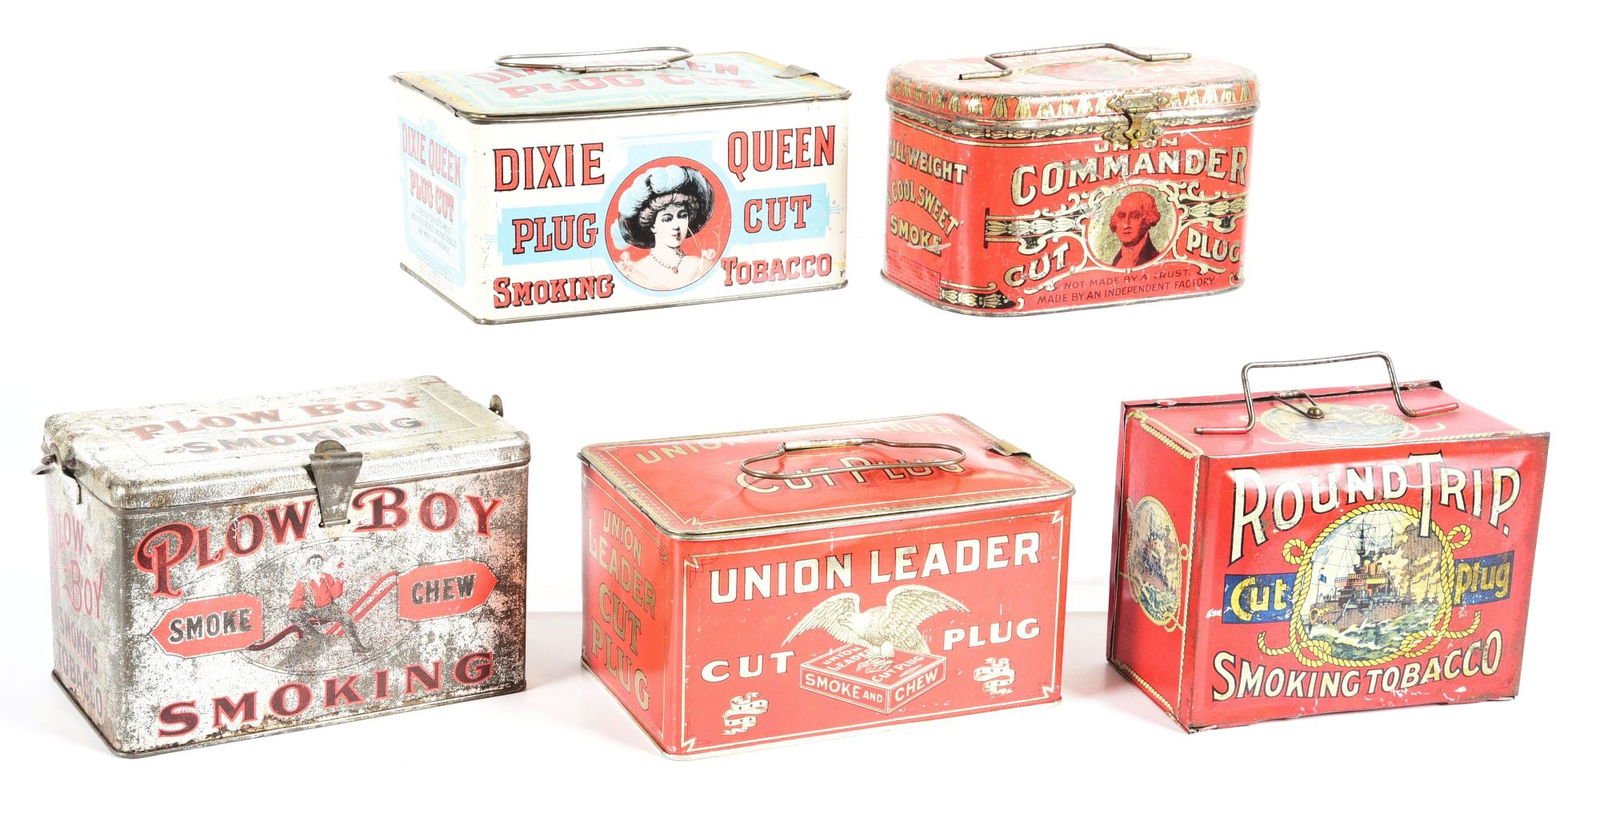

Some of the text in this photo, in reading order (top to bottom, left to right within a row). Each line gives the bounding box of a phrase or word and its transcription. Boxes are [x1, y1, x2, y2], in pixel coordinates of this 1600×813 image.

[497, 74, 758, 99] PLUG CUT
[402, 122, 461, 188] DIXIE QUEEN
[492, 125, 836, 192] DIXIE QUEEN
[908, 146, 968, 185] WEIGHT
[1010, 146, 1248, 207] COMMANDER
[409, 168, 434, 209] PLUG
[435, 185, 455, 223] CUT
[512, 195, 812, 255] PLUG CUT
[891, 178, 916, 203] COOL
[917, 184, 960, 237] SWEET
[890, 213, 942, 256] SMOKE
[1003, 227, 1242, 289] CUT PLUG
[493, 253, 832, 308] SMOKING TOBACCO
[1037, 295, 1068, 305] MADE
[1071, 293, 1084, 302] BY
[1087, 289, 1101, 300] AN
[1104, 282, 1169, 298] INDEPENDENT
[1063, 281, 1085, 290] NOT
[1089, 278, 1118, 288] MADE
[130, 396, 424, 442] PLOW BOY
[181, 417, 422, 457] SMOKING
[736, 456, 966, 493] CUT PLUG
[134, 486, 503, 599] PLOW BOY
[602, 508, 643, 568] UNION
[1228, 464, 1409, 567] ROUND
[63, 558, 104, 620] BOY
[411, 574, 477, 606] CHEW
[588, 518, 657, 621] LEADER
[709, 531, 1042, 605] UNION LEADER
[167, 608, 253, 645] SMOKE
[599, 582, 643, 657] CUT
[1230, 575, 1287, 622] Cut
[591, 616, 651, 712] PLUG
[700, 617, 1042, 684] CUT PLUG
[822, 646, 862, 666] UNION
[872, 655, 925, 682] CUT PLUG
[1212, 629, 1503, 702] SMOKING TOBACCO
[158, 651, 495, 738] SMOKING
[804, 667, 939, 703] SMOKE AND CHEW
